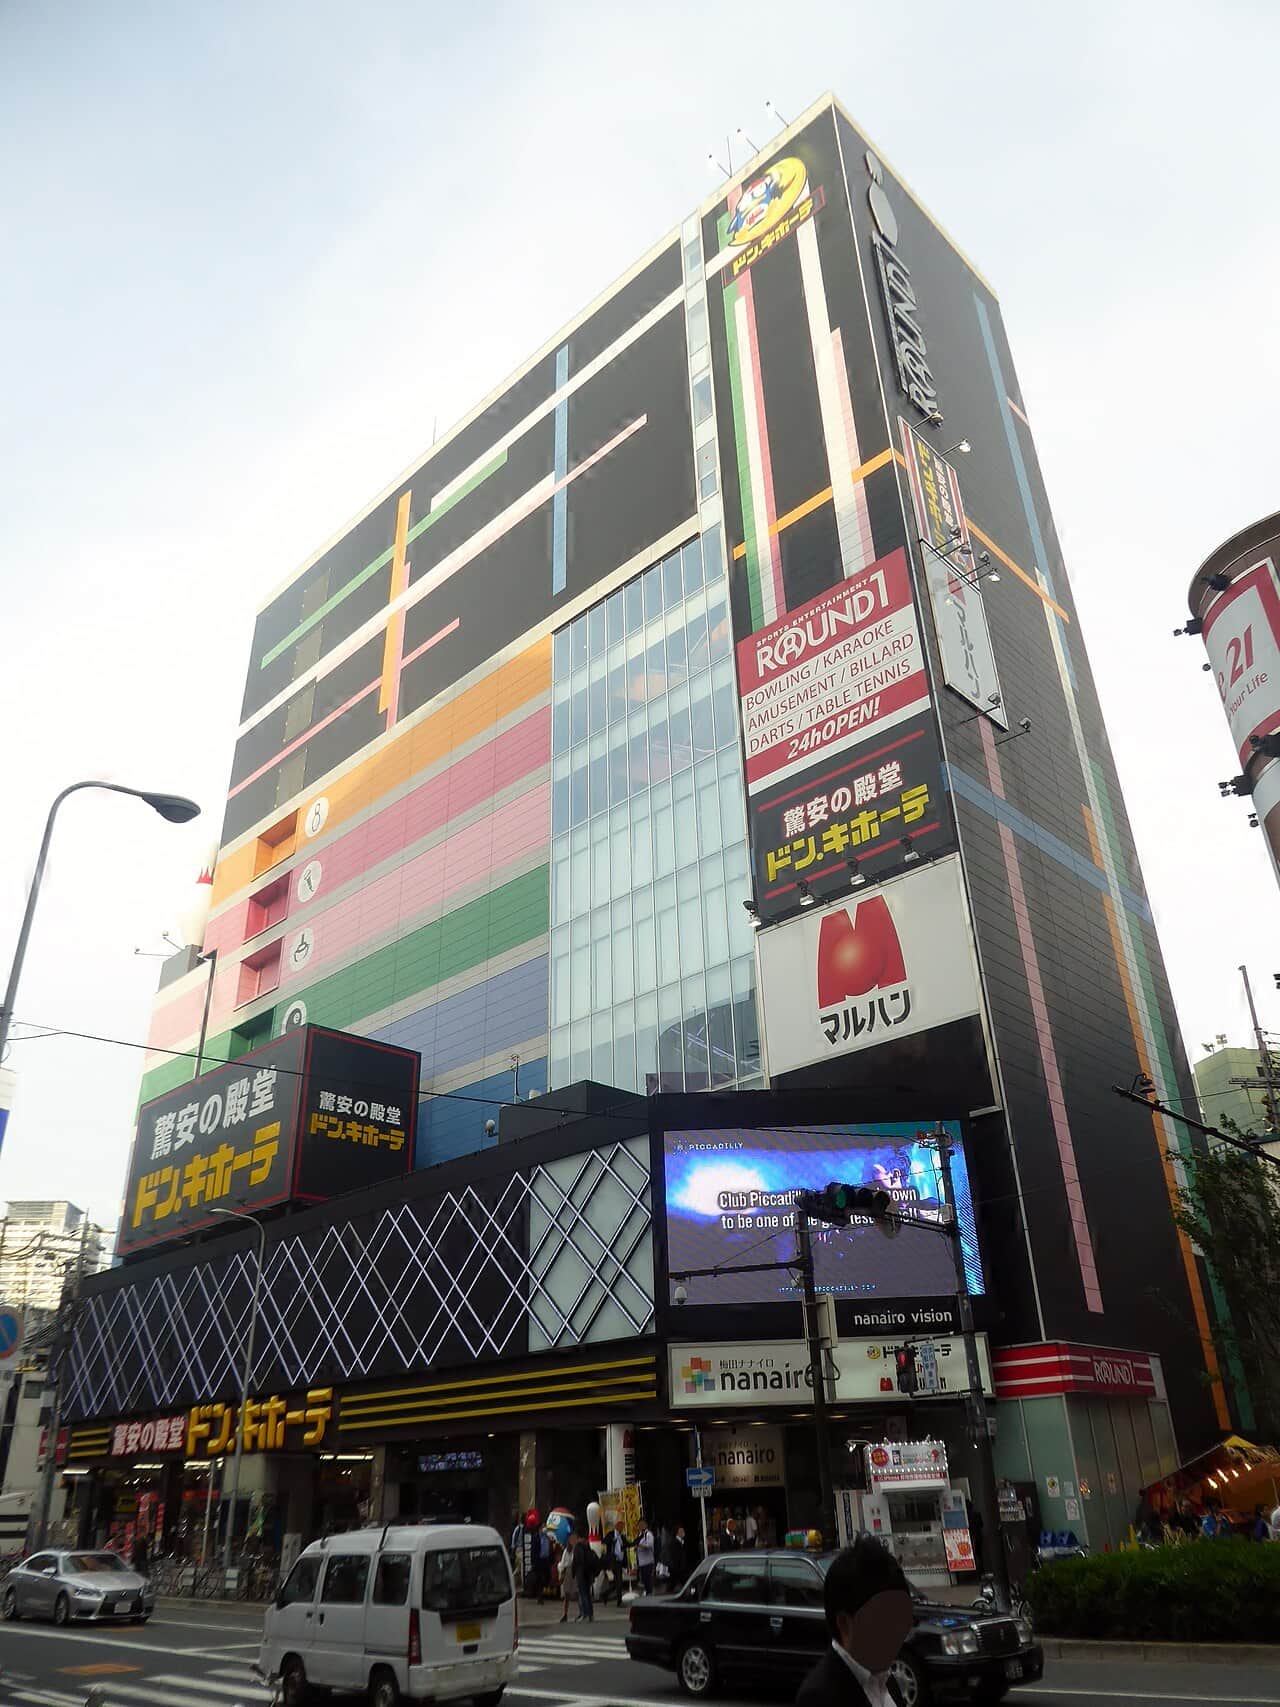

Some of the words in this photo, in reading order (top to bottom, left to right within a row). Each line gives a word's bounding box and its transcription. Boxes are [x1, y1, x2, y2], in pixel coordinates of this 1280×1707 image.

[756, 624, 789, 647] SPORTS
[792, 579, 868, 627] ENTERTAINMENT
[746, 665, 811, 710] BOWLING
[823, 620, 894, 668] KARAOKE
[748, 673, 837, 732] AMUSEMENT
[850, 633, 914, 678] BILLARD
[1226, 624, 1254, 688] 21
[1246, 671, 1269, 695] Life
[750, 721, 794, 753] DARTS
[806, 689, 851, 723] TABLE
[854, 659, 911, 698] TENNIS
[787, 696, 881, 759] 24hOPEN!
[783, 761, 903, 838] 驚安の殿堂
[820, 989, 911, 1045] マルハン
[150, 1064, 277, 1160] 驚安の殿堂
[319, 1090, 402, 1126] 驚安の殿堂
[719, 1192, 747, 1208] Club
[721, 1215, 734, 1229] to
[737, 1213, 753, 1229] be
[756, 1214, 779, 1228] one
[782, 1212, 795, 1227] of
[854, 1311, 905, 1325] nanairo
[911, 1310, 953, 1323] vision
[111, 1415, 188, 1456] 驚安の殿堂
[718, 1443, 775, 1465] nanairo
